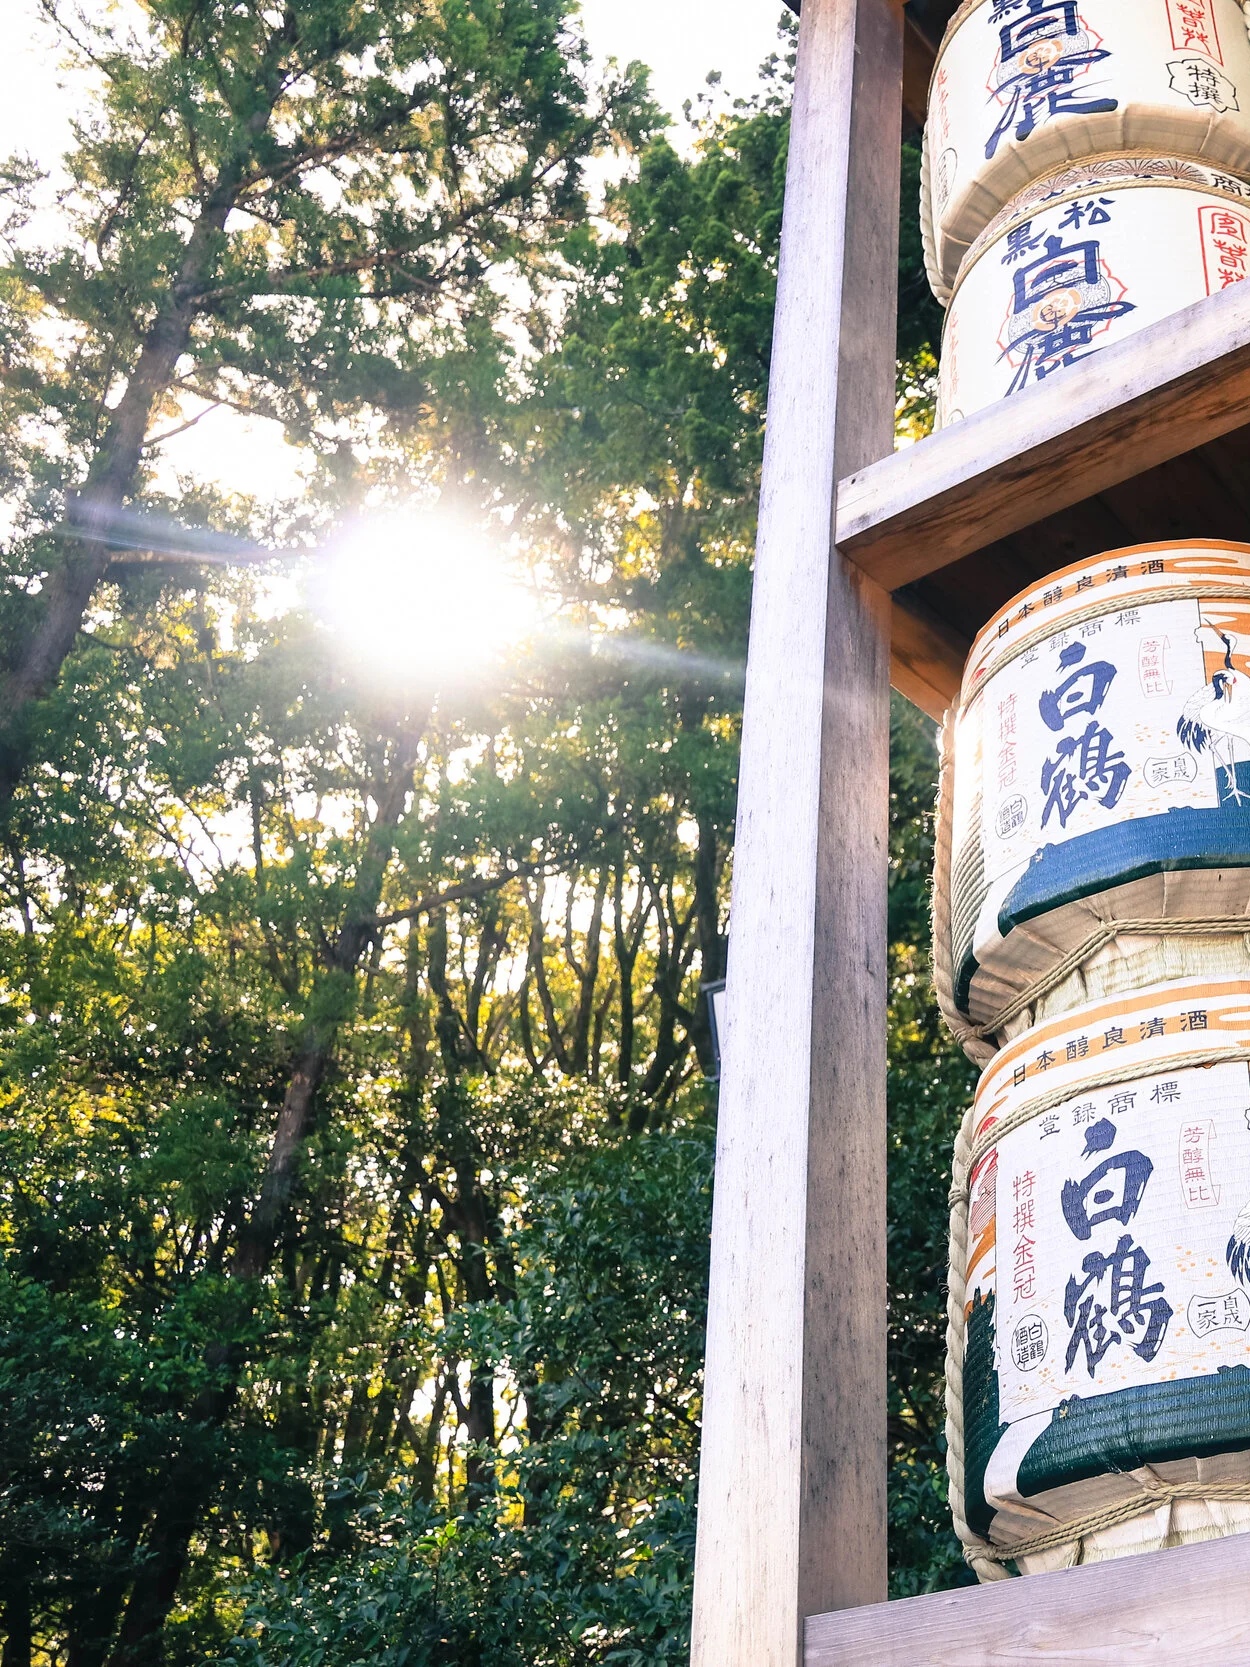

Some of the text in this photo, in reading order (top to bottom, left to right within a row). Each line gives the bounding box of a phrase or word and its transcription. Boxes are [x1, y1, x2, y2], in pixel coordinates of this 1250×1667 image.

[1186, 64, 1224, 105] 特撰
[1001, 196, 1116, 266] 黒松
[999, 558, 1165, 639] 日本醇良清酒
[1021, 609, 1141, 669] 登録商標
[1142, 640, 1165, 694] 芳醇無比
[998, 692, 1018, 793] 特撰金冠
[1038, 641, 1133, 830] 白鶴
[1013, 1009, 1208, 1087] 日本醇良清酒
[1039, 1080, 1181, 1141] 登録商標
[1182, 1126, 1211, 1202] 芳醇無比
[1012, 1170, 1037, 1304] 特撰金冠
[1061, 1116, 1175, 1379] 白鶴
